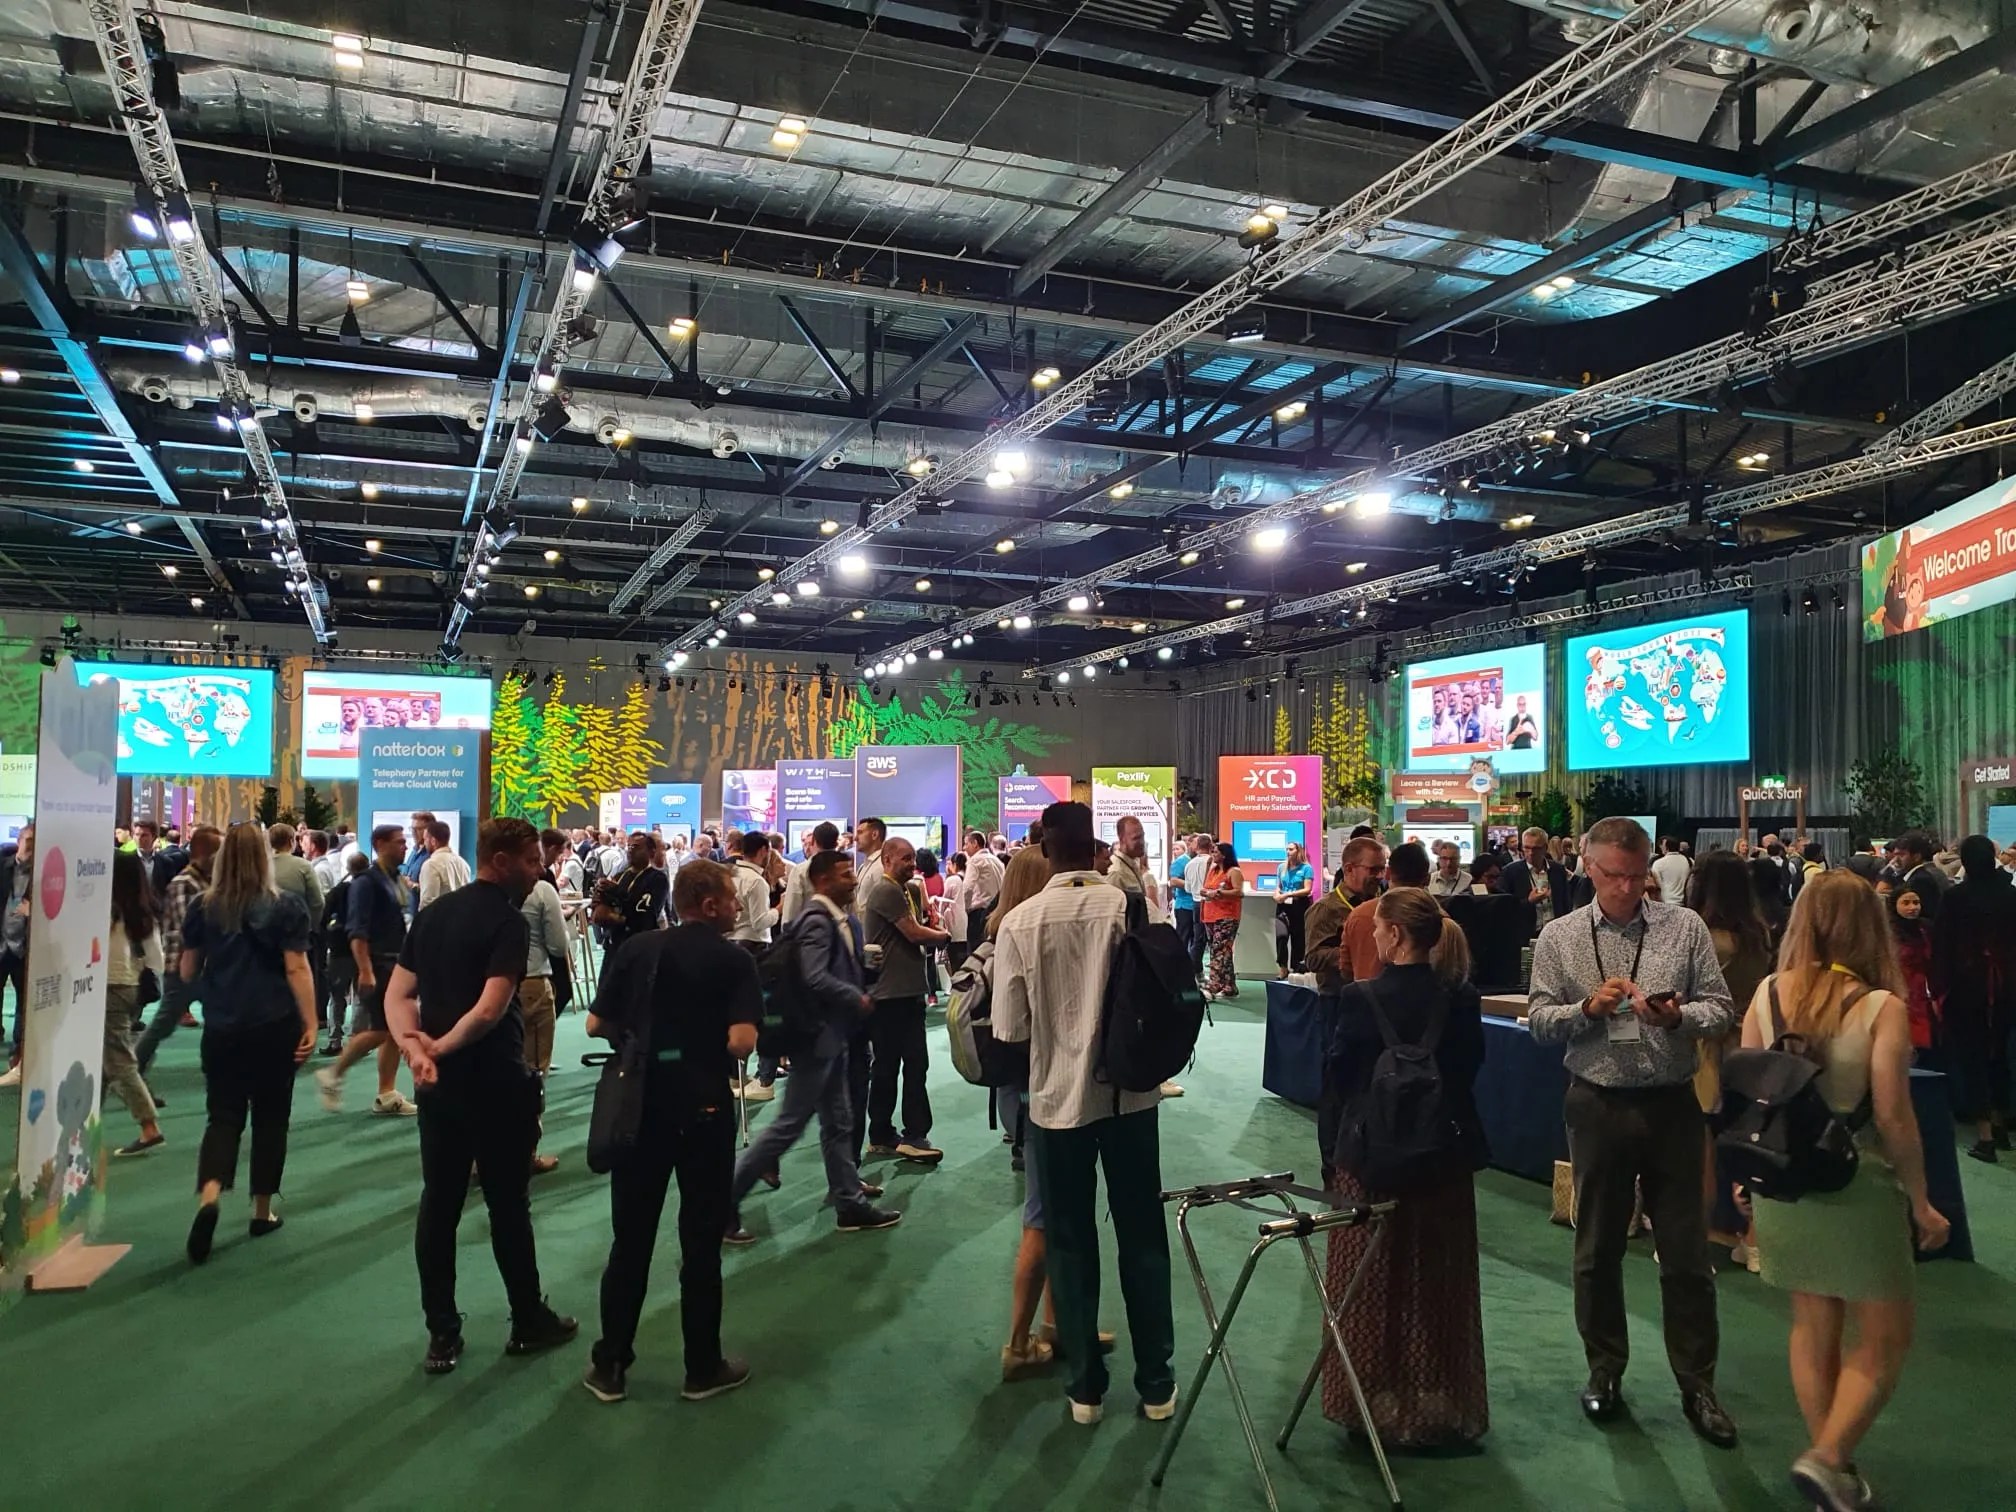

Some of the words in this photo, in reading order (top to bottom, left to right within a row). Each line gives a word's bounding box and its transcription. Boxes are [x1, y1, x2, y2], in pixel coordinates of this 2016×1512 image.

[1923, 539, 1992, 582] Welcome
[372, 741, 446, 757] natterbox
[867, 756, 897, 769] aws
[372, 768, 417, 778] Telephony
[418, 768, 450, 777] Partner
[452, 768, 465, 777] for
[1117, 771, 1151, 783] Pexlify
[1242, 769, 1297, 789] XCD
[1974, 767, 1987, 783] Get
[1987, 763, 2010, 781] Started
[372, 780, 405, 788] Service
[406, 780, 431, 788] Cloud
[433, 780, 458, 788] Voice
[1400, 779, 1423, 787] Leave
[1432, 779, 1459, 787] Review
[1742, 787, 1775, 800] Quick
[1776, 786, 1802, 799] Start
[1261, 804, 1270, 812] by
[77, 858, 106, 877] Deloitte
[72, 974, 94, 1005] pwc
